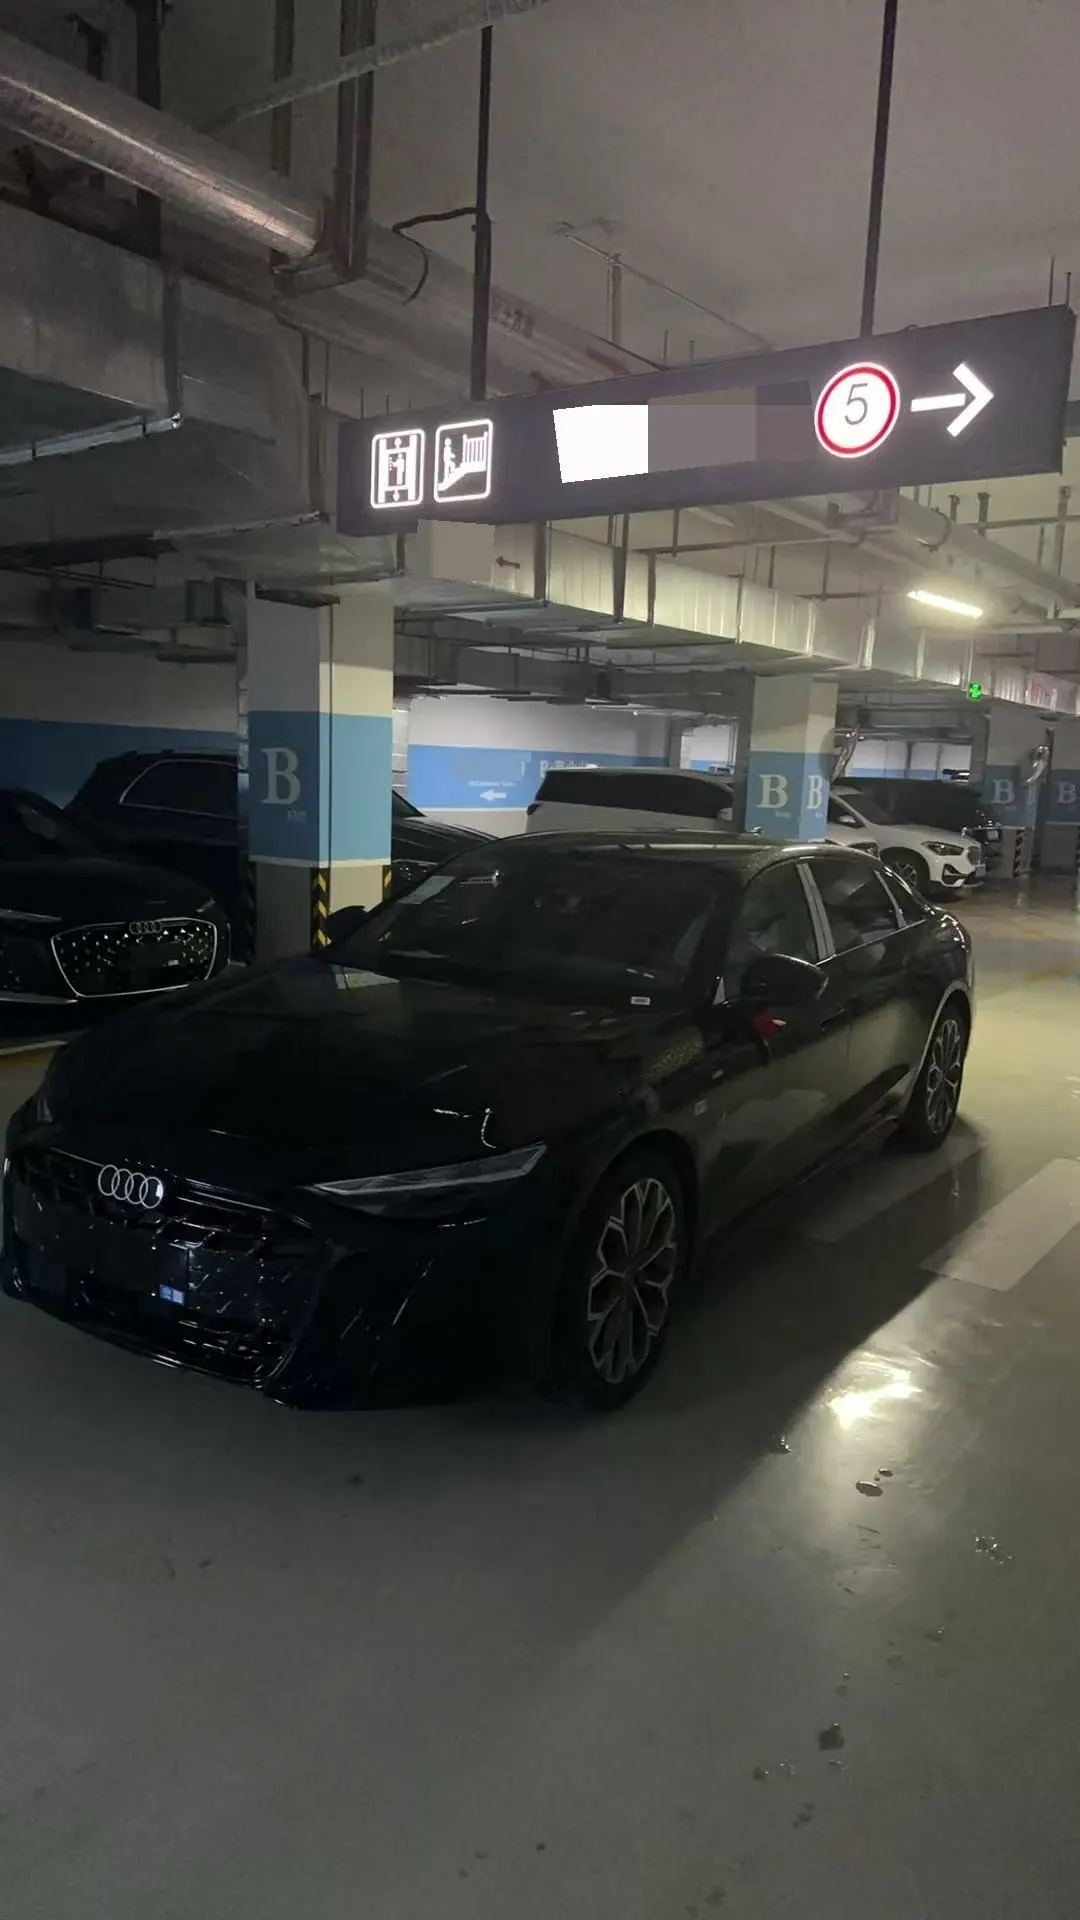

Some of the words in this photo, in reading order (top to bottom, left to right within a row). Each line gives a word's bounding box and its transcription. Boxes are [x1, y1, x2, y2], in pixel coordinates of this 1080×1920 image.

[845, 383, 869, 425] 5
[260, 747, 301, 805] B
[756, 773, 788, 809] B
[806, 774, 823, 810] B
[989, 778, 1015, 804] B
[1055, 781, 1077, 803] B
